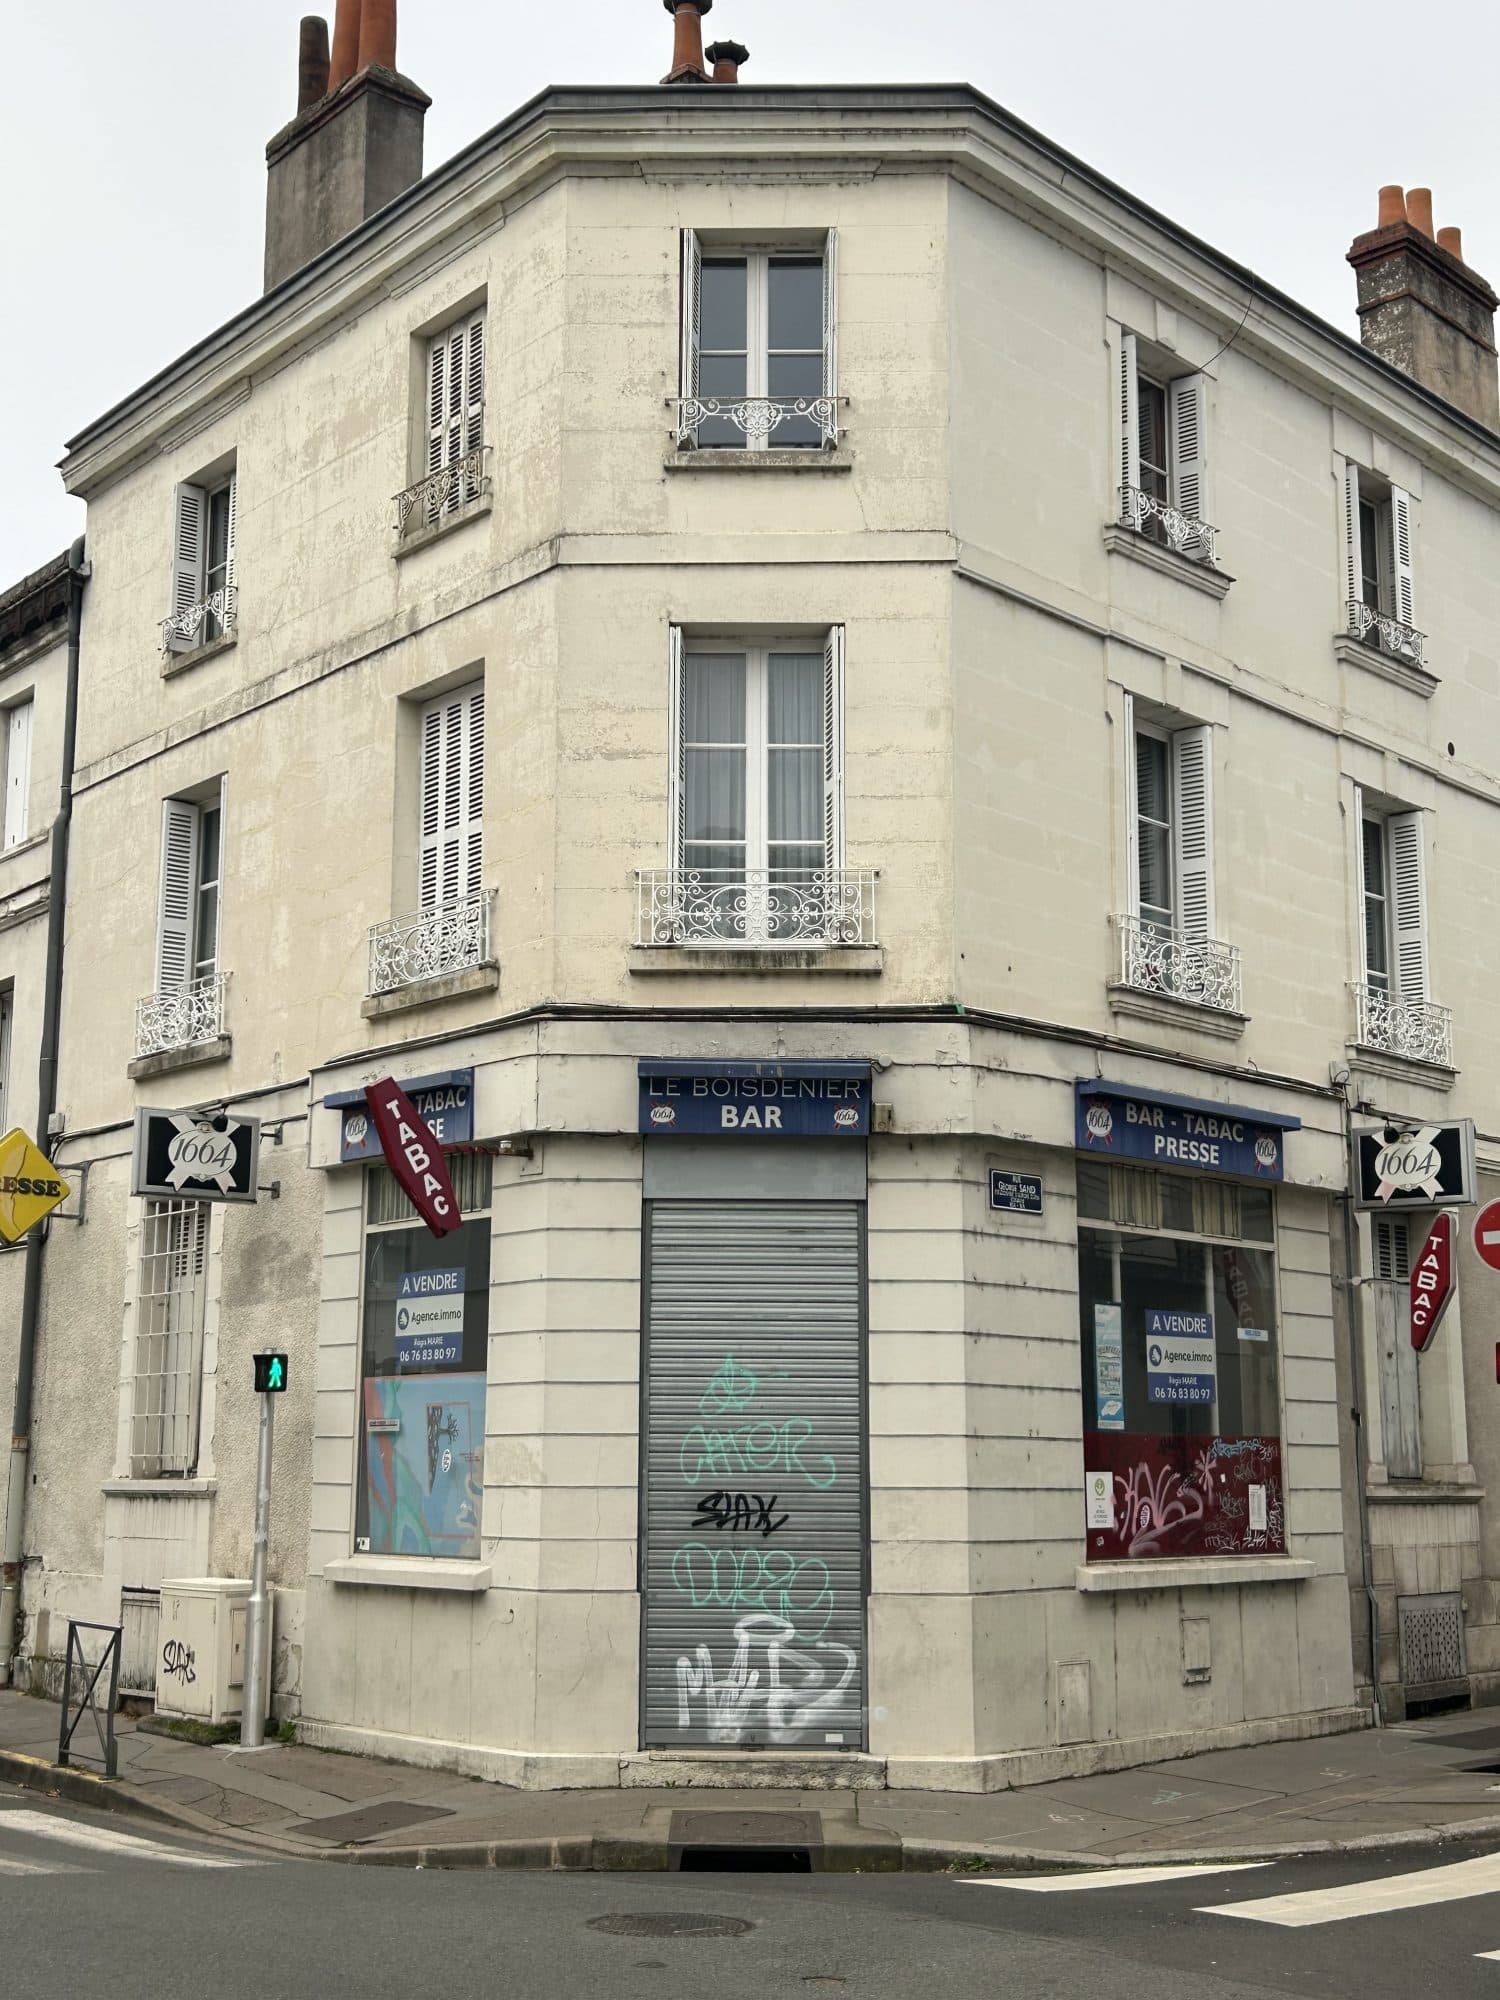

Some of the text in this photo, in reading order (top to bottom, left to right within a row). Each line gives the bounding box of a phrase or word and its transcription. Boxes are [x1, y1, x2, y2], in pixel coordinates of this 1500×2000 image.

[649, 1077, 862, 1099] LE BOISDENIER
[415, 1087, 467, 1114] TABAC
[651, 1108, 676, 1121] 1664
[721, 1104, 783, 1129] BAR
[835, 1109, 859, 1122] 1664
[1088, 1107, 1111, 1131] 1664
[1126, 1102, 1165, 1129] BAR
[1183, 1112, 1245, 1143] TABAC
[347, 1117, 367, 1137] 1664
[173, 1137, 234, 1168] 1664
[386, 1099, 449, 1215] TABAC
[1154, 1134, 1220, 1165] PRESSE
[1256, 1138, 1277, 1160] 1664
[1380, 1148, 1438, 1176] 1664
[0, 1175, 61, 1197] ESSE
[1019, 1183, 1036, 1194] SAND
[402, 1272, 458, 1294] A VENDRE
[1413, 1235, 1443, 1326] TABAC
[411, 1309, 462, 1325] Agence.immo
[1152, 1314, 1207, 1334] A VENDRE
[400, 1347, 456, 1361] 06 76 83 80 97
[1164, 1349, 1213, 1363] Agence.immo
[1155, 1387, 1210, 1399] 06 76 83 80 97
